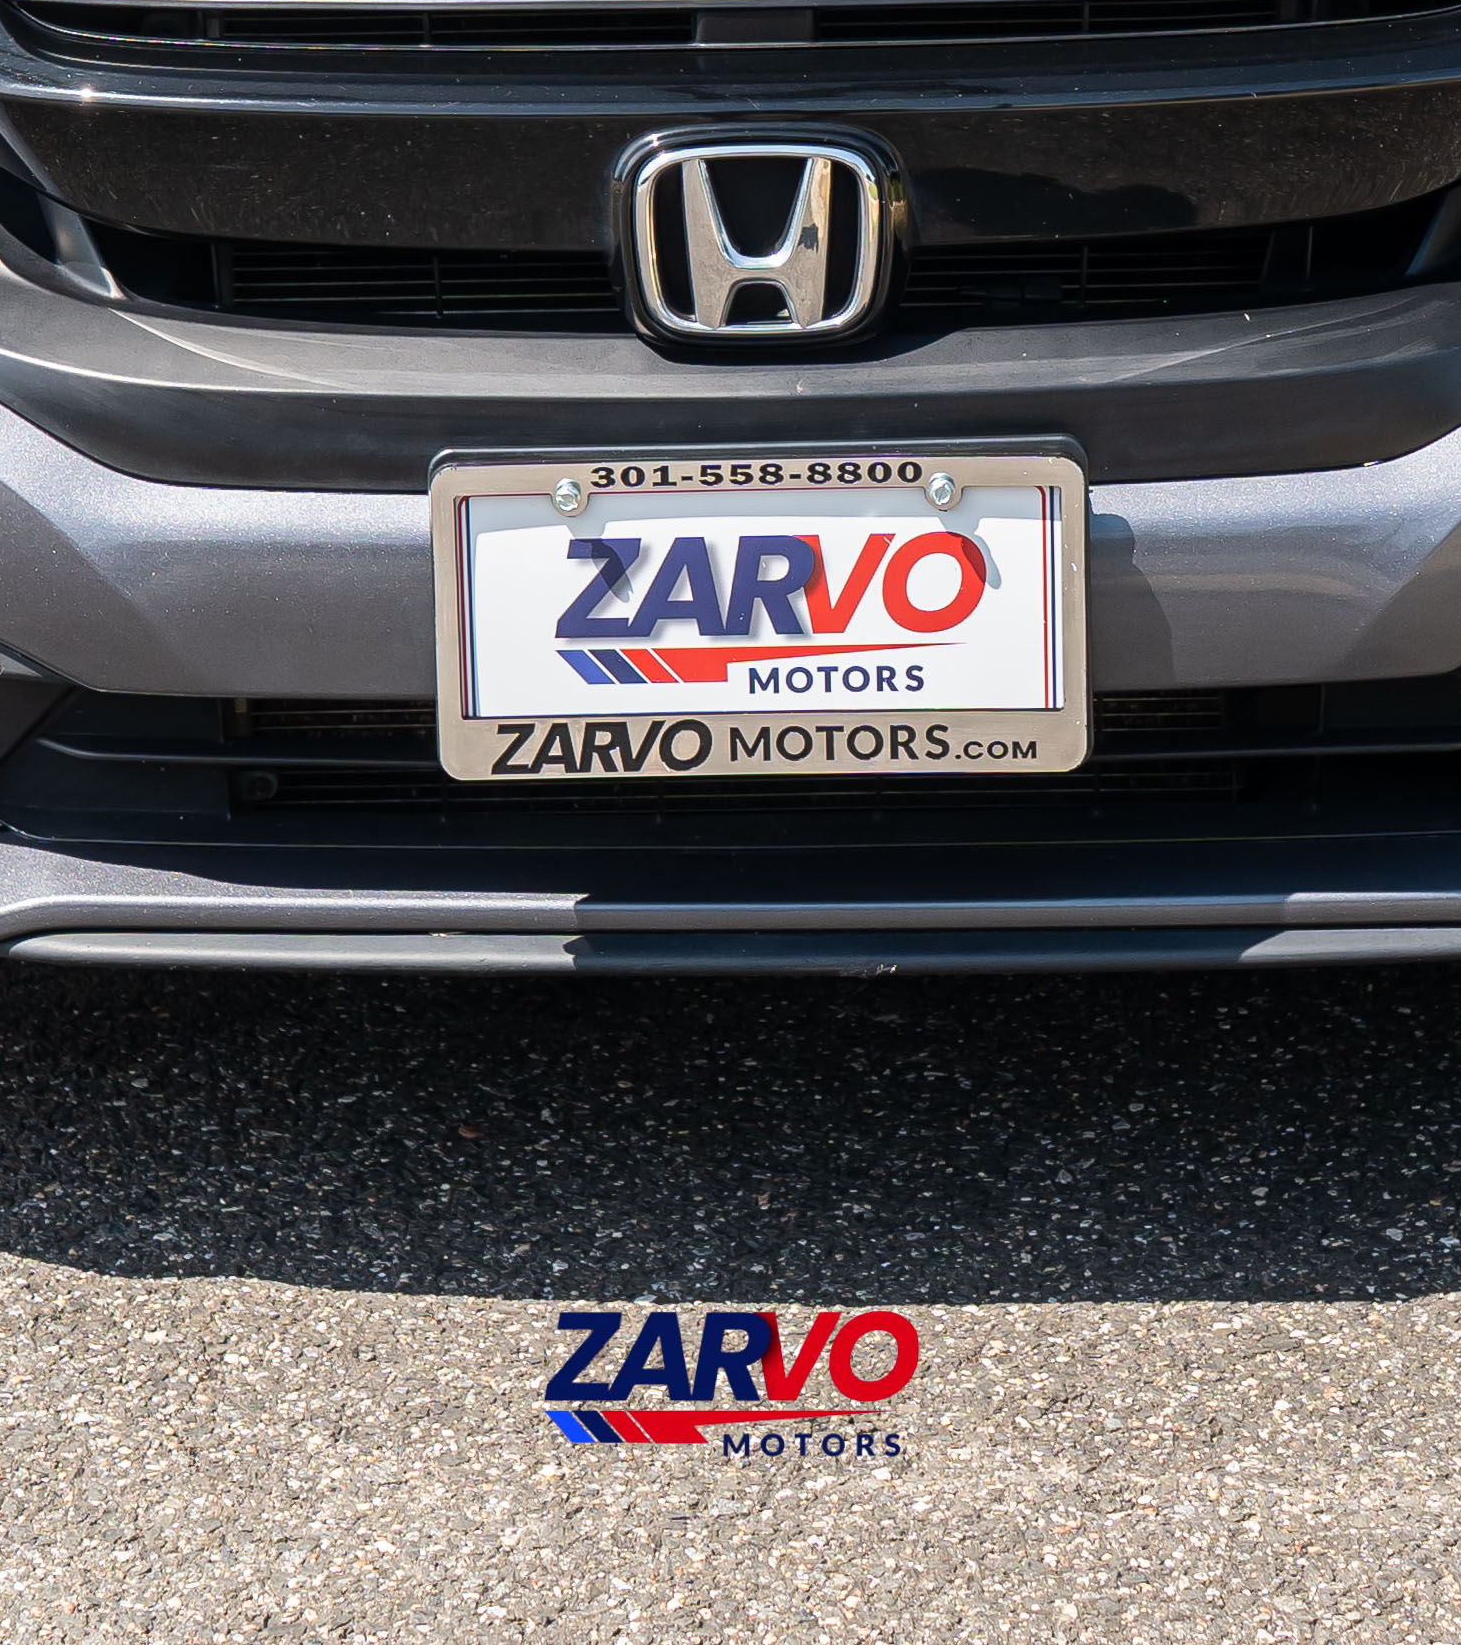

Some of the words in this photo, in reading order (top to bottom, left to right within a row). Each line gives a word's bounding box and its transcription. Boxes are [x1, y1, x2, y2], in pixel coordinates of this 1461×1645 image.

[590, 461, 923, 487] 301-558-8800
[554, 531, 987, 639] ZARVO
[748, 665, 925, 694] MOTORS
[491, 719, 712, 775] ZARVO
